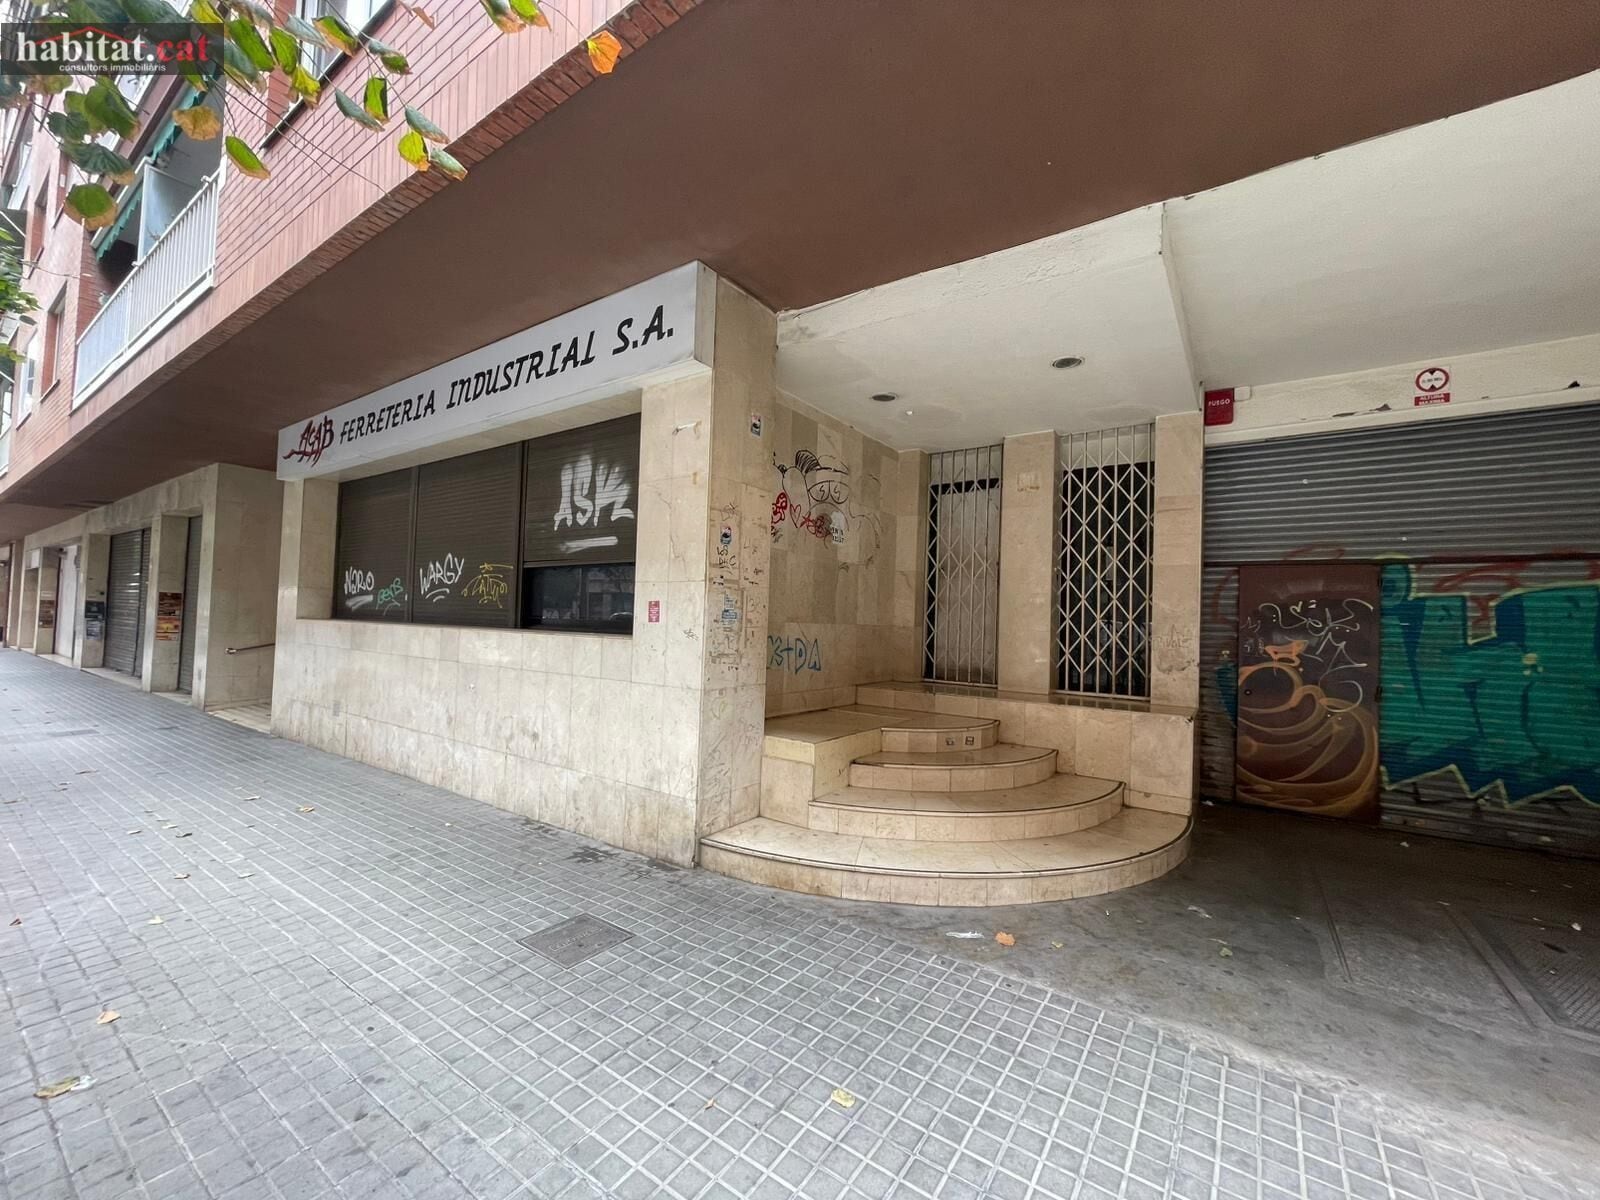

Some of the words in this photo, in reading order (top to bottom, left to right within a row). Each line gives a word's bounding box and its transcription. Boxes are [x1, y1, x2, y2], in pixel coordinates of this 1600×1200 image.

[339, 390, 436, 445] FERRETERIA
[446, 330, 596, 410] INDUSTRIAL
[611, 304, 675, 355] S.A.
[1208, 398, 1231, 406] FUEGO
